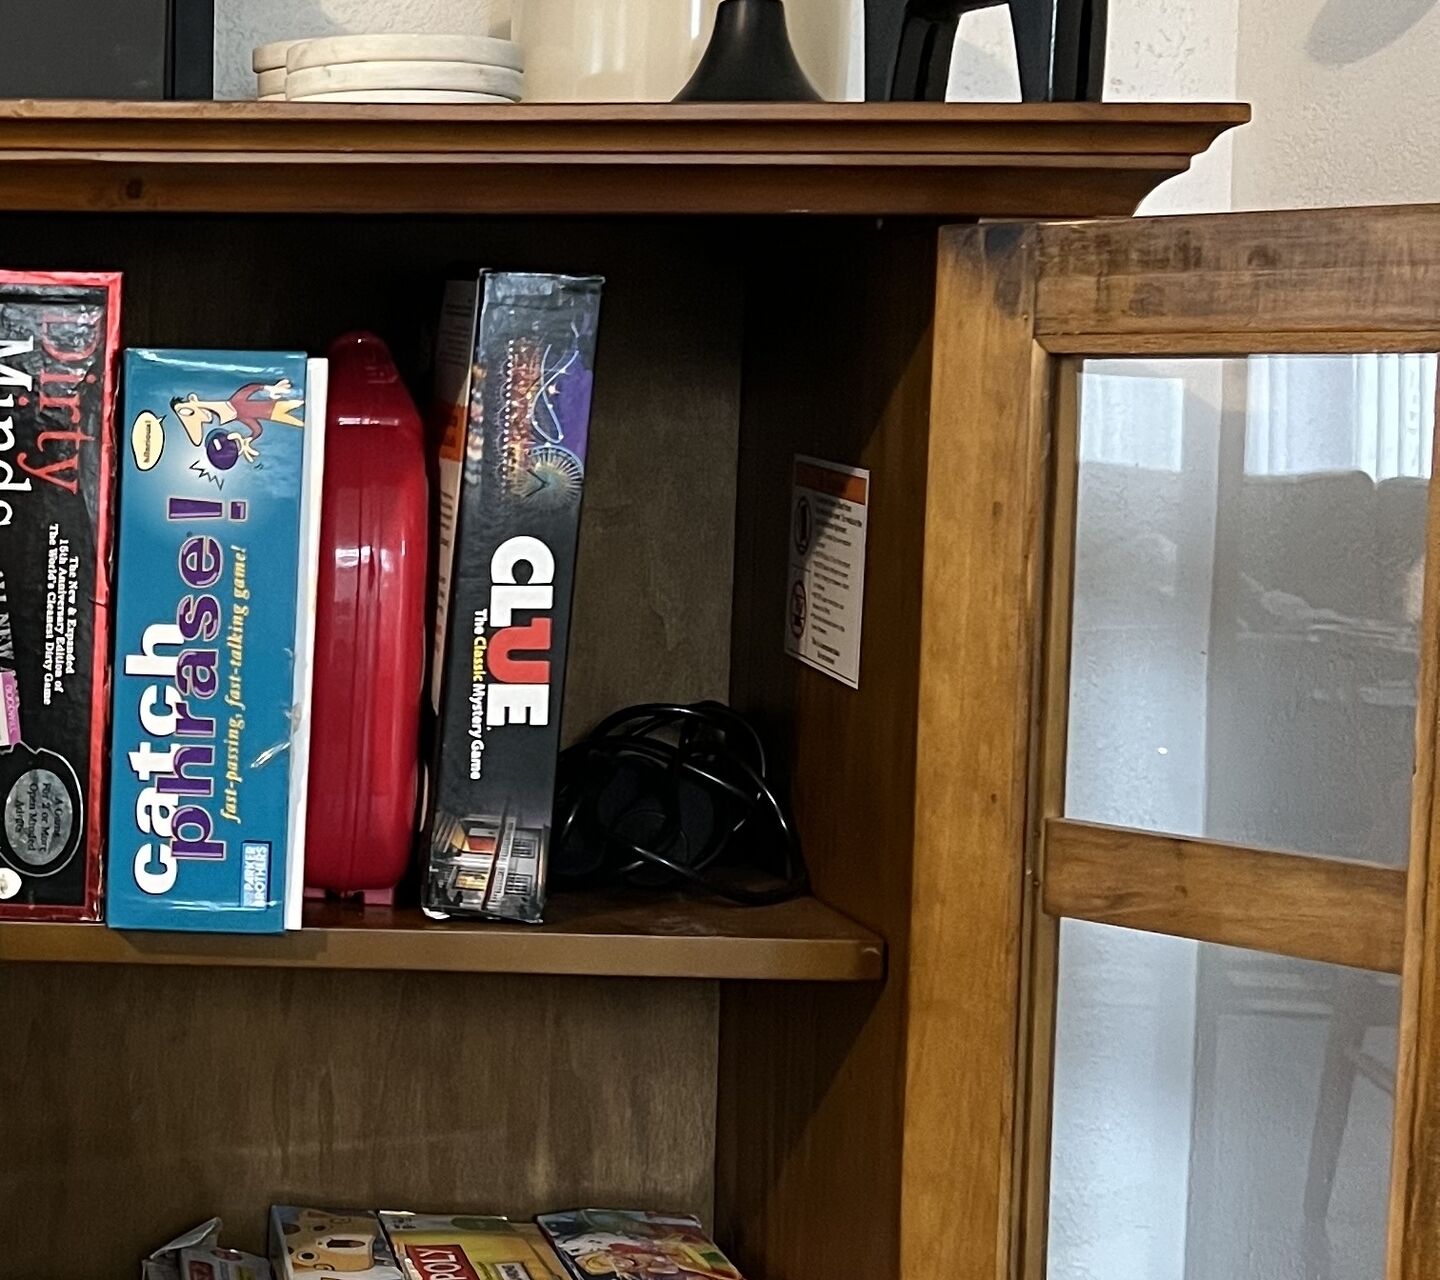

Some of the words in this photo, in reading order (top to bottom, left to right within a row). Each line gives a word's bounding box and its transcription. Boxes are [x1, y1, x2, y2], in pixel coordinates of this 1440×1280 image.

[17, 311, 102, 495] Dirty
[230, 545, 251, 601] game!
[474, 608, 487, 635] The
[156, 495, 249, 860] phrase!
[224, 602, 250, 710] fast-talking
[472, 636, 487, 682] Classic
[486, 535, 555, 726] CLUE
[125, 623, 184, 895] catch
[468, 683, 486, 739] Mystery
[470, 740, 485, 780] Game
[220, 713, 245, 824] fast-passing,
